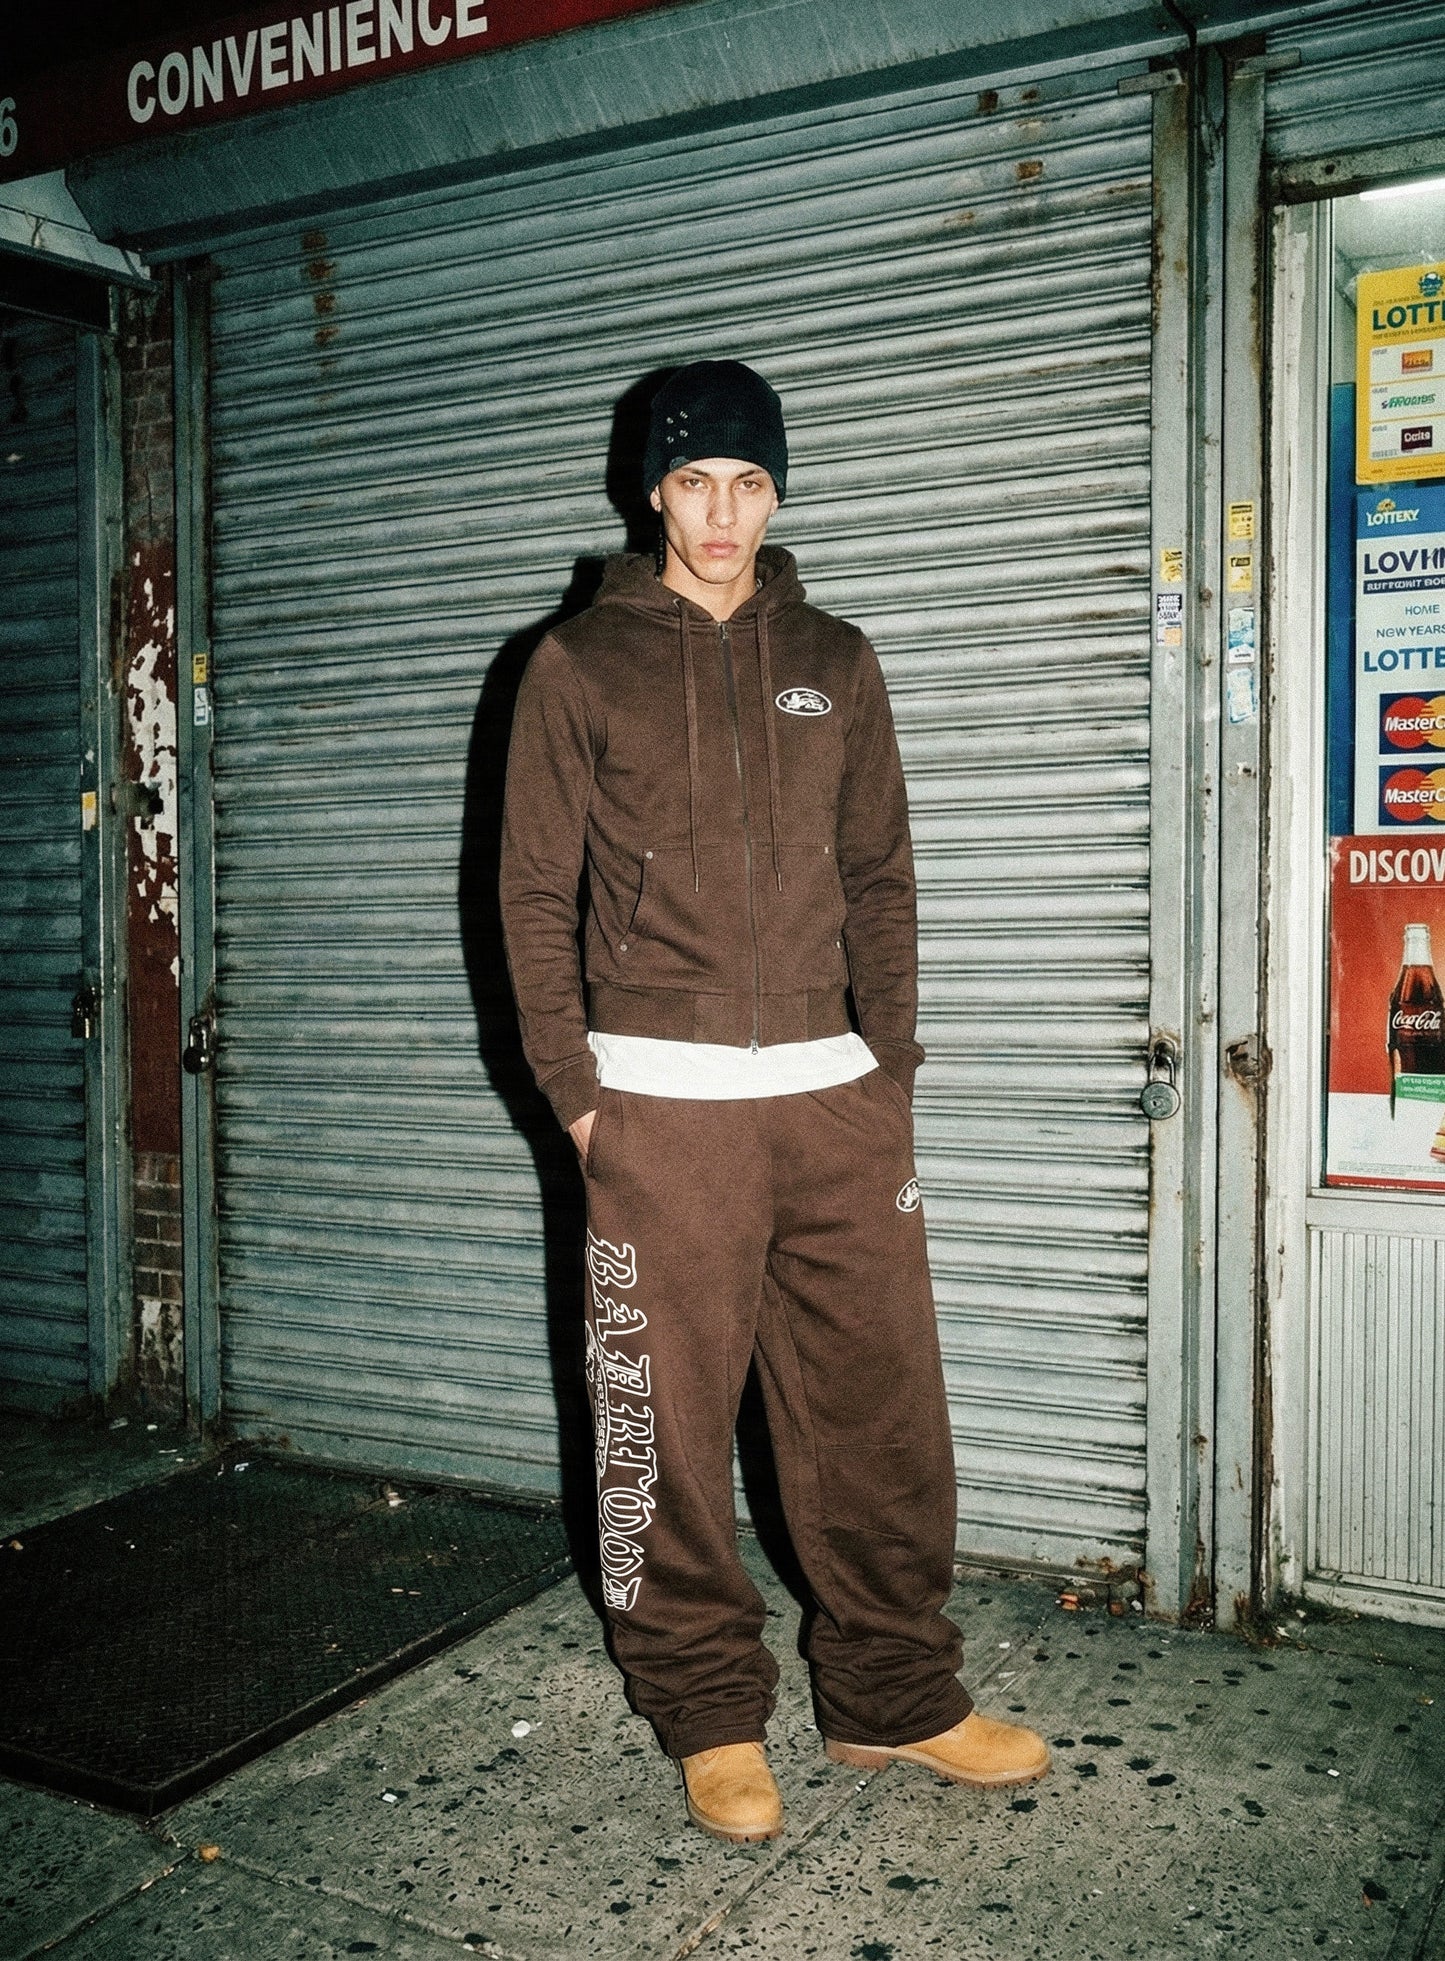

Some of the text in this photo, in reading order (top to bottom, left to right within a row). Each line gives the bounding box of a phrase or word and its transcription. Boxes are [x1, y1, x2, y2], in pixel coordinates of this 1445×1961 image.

[128, 0, 488, 123] CONVENIENCE
[0, 97, 18, 156] 6
[1373, 300, 1445, 331] LOTT
[1366, 509, 1420, 526] LOTTERY
[1405, 604, 1440, 615] HOME
[1364, 647, 1445, 672] LOTTE
[1350, 848, 1445, 883] DISCOV
